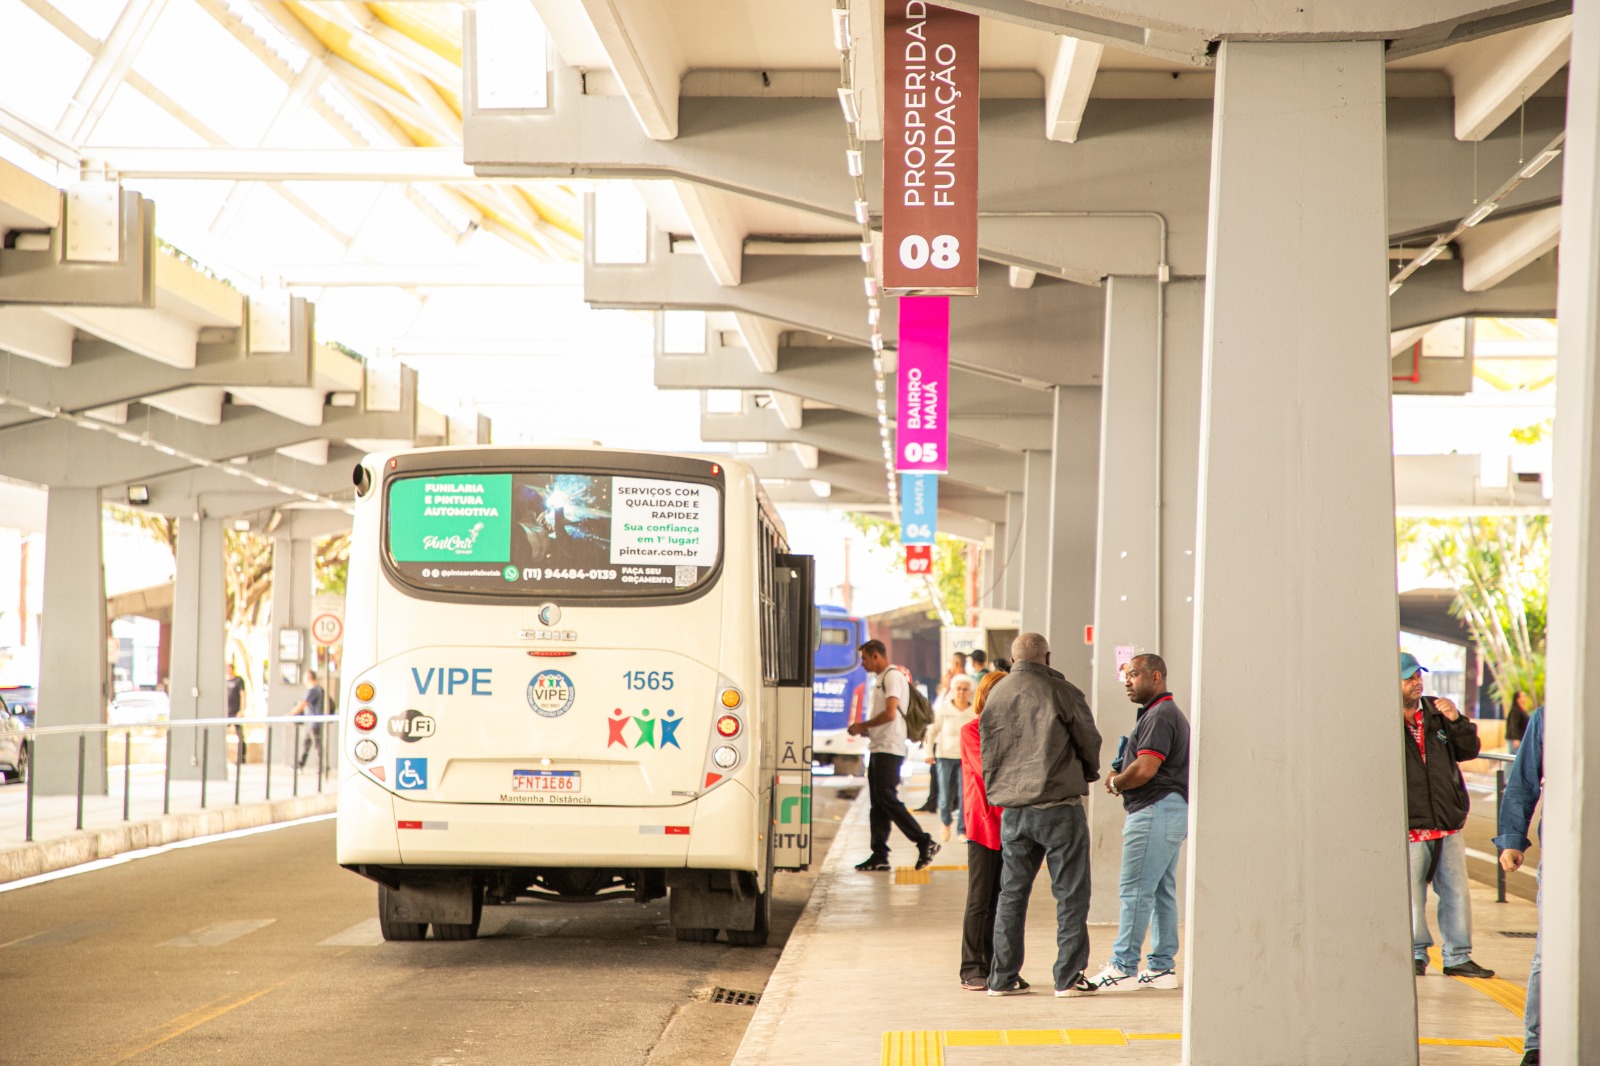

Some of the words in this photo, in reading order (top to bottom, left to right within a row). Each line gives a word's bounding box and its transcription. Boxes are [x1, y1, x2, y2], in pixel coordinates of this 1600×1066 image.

[931, 43, 961, 206] FUNDAÇÃO
[899, 234, 961, 269] 08
[907, 367, 922, 430] BAIRRO
[923, 381, 938, 429] MAUÁ
[904, 442, 938, 463] 05
[424, 484, 484, 493] FUNILARIA
[618, 487, 671, 496] SERVIÇOS
[424, 495, 432, 504] E
[434, 495, 483, 505] PINTURA
[913, 479, 925, 515] SANTA
[625, 499, 689, 508] QUALIDADE
[693, 500, 699, 508] E
[423, 507, 498, 517] AUTOMOTIVA
[651, 511, 699, 520] RAPIDEZ
[624, 523, 643, 531] Sua
[646, 523, 699, 534] confiança
[906, 523, 931, 539] 04
[668, 536, 699, 546] lugar!
[619, 546, 698, 557] pintcar.com.br
[908, 558, 929, 572] 07
[523, 568, 542, 581] (11)
[544, 568, 617, 580] 94484-0139
[621, 567, 643, 576] FAÇA
[621, 576, 673, 585] ORÇAMENTO
[320, 621, 336, 633] 10
[411, 667, 493, 696] VIPE
[623, 671, 674, 690] 1565
[534, 688, 567, 701] VIPE
[518, 776, 573, 790] FNT1E86
[500, 794, 544, 803] Mantenha
[549, 795, 592, 804] Distância
